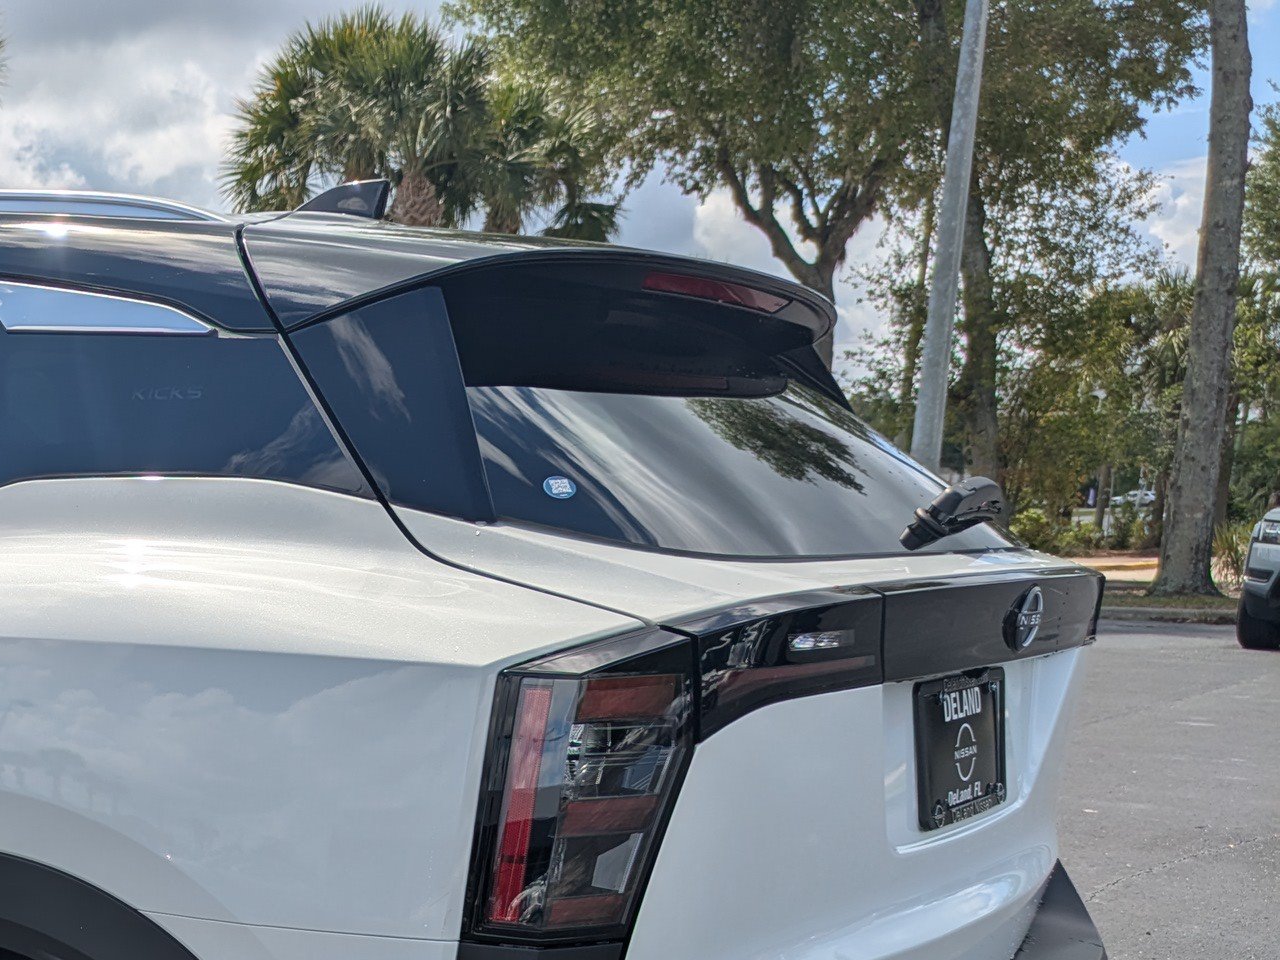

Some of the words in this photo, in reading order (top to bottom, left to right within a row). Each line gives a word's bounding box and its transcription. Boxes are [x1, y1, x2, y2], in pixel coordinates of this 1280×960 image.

[132, 386, 203, 401] KICKS
[943, 686, 982, 722] DELAND
[955, 745, 977, 760] NISSAN
